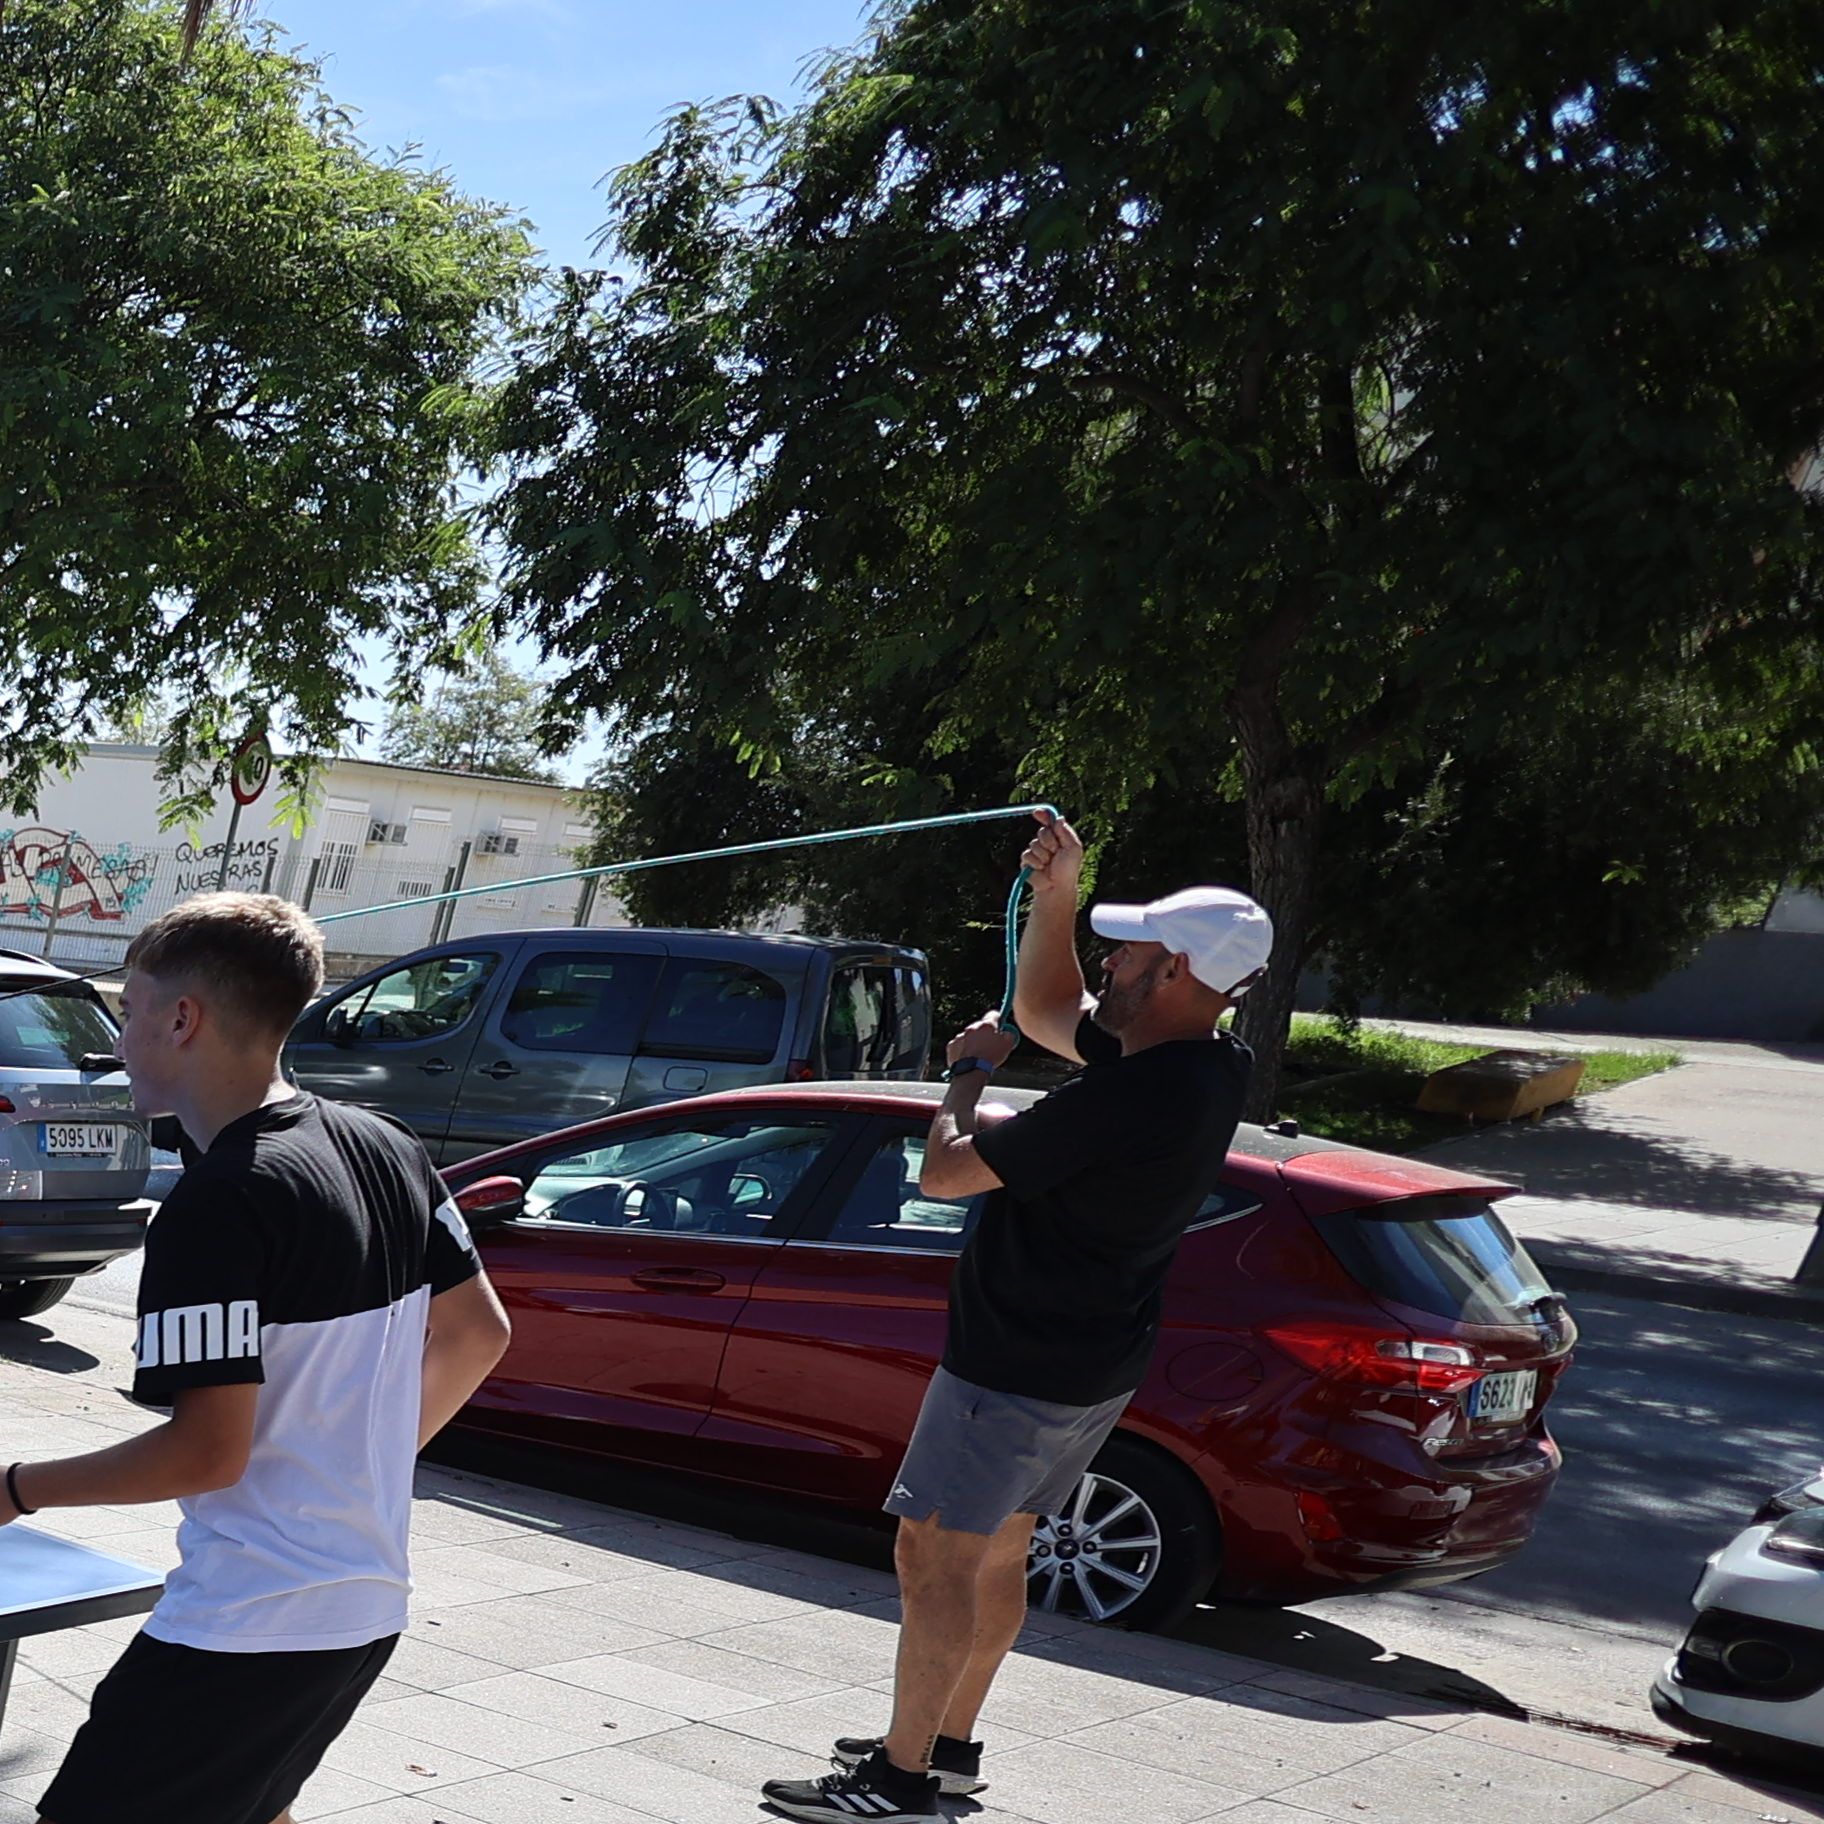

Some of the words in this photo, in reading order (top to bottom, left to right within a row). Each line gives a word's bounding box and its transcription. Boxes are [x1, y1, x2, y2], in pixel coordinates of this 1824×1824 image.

[174, 861, 263, 895] NUESRAS
[49, 1127, 85, 1148] 5095
[89, 1127, 113, 1148] LKM
[136, 1299, 259, 1369] UMA
